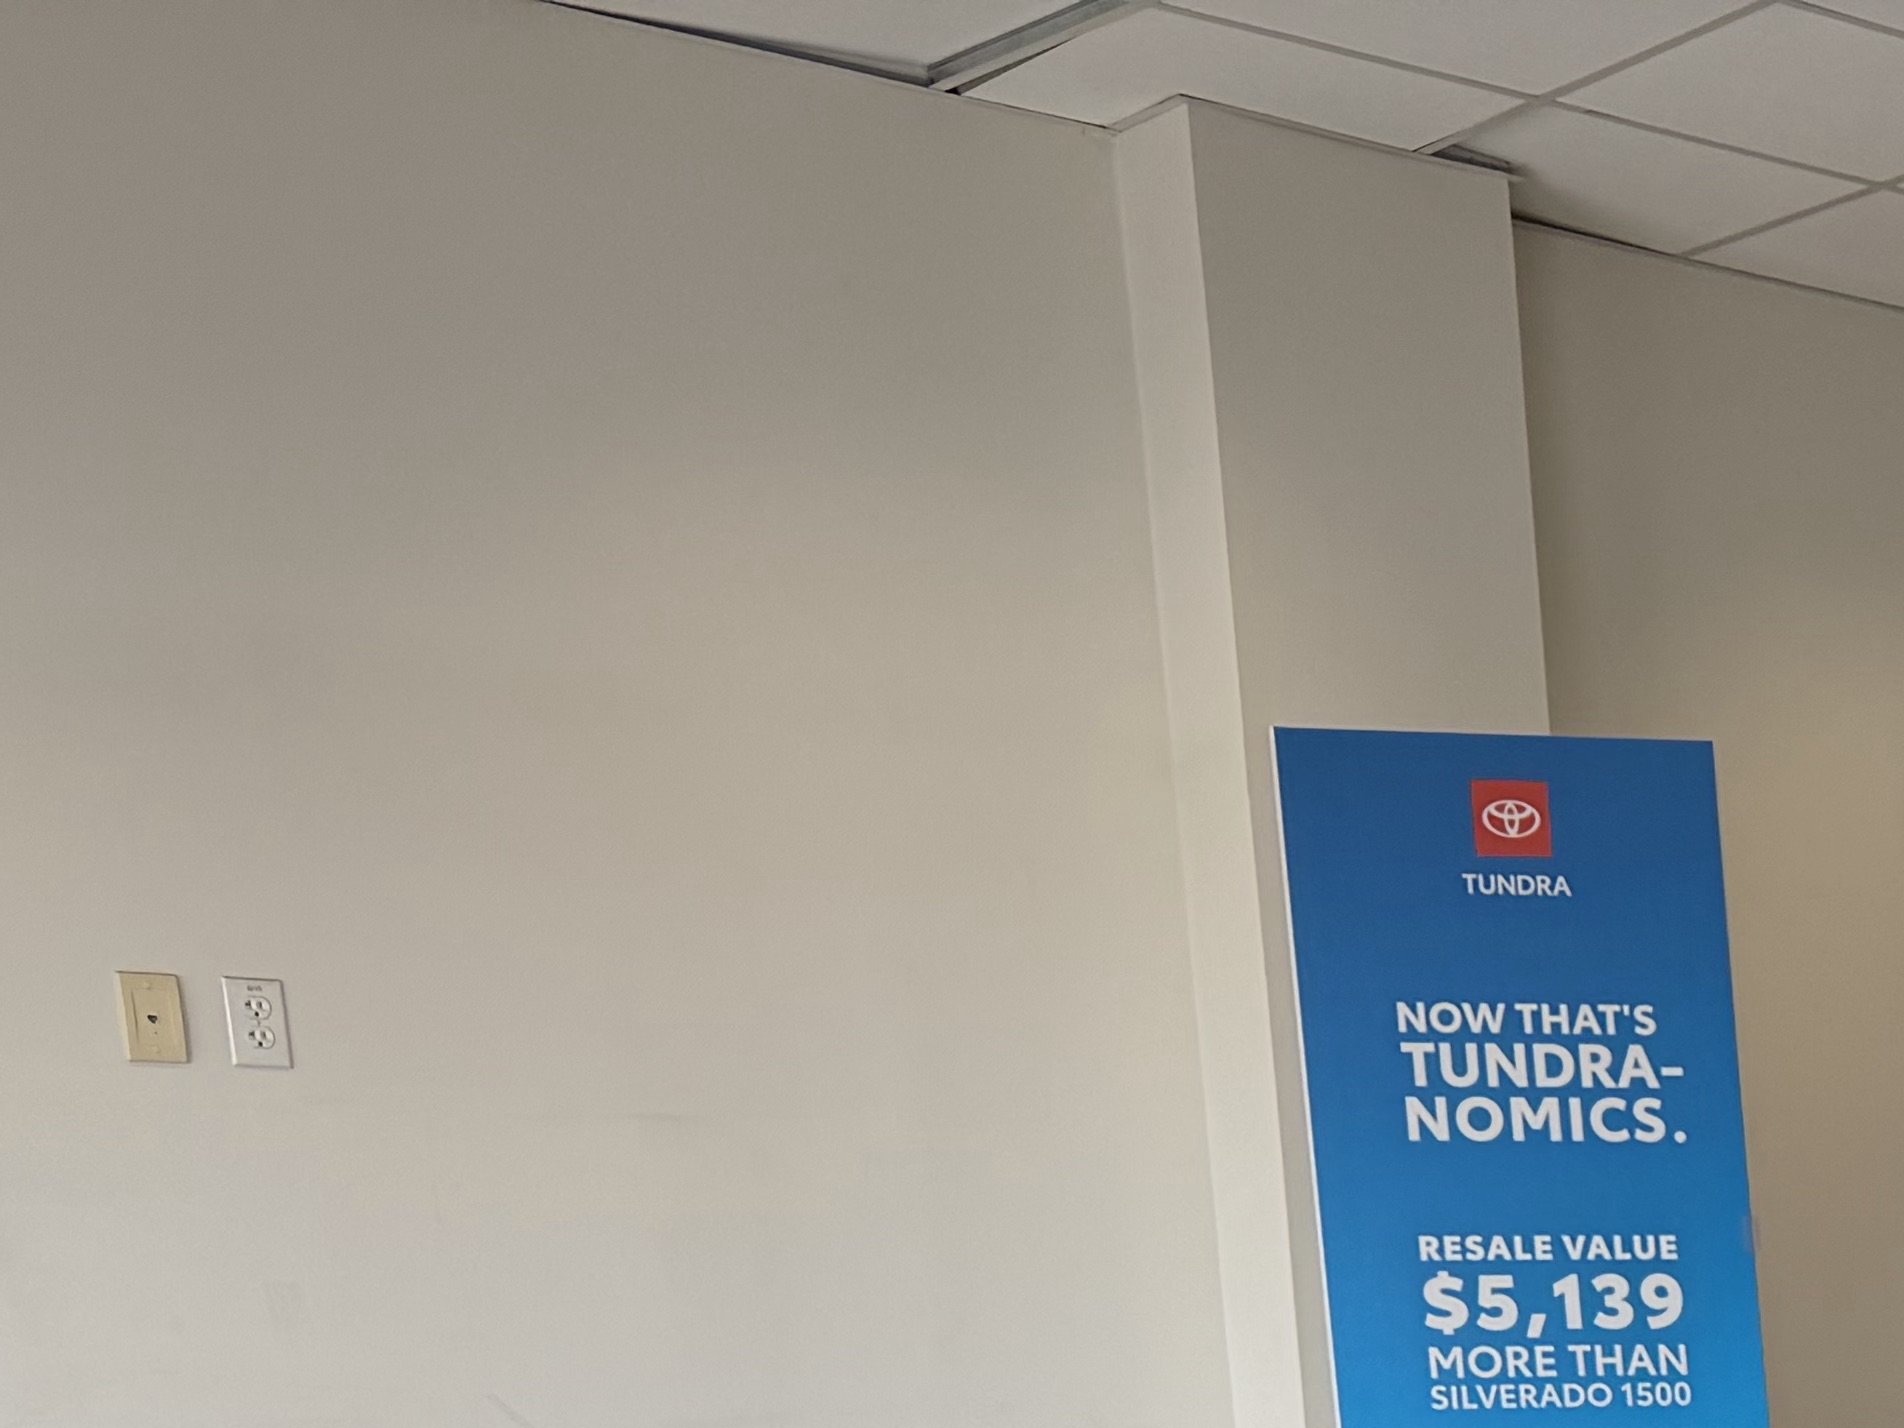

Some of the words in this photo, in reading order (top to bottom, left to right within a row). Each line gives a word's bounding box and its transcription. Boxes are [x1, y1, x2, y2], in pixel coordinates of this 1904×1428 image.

[1462, 873, 1572, 897] TUNDRA
[1395, 1001, 1503, 1034] NOW
[1514, 1003, 1657, 1037] THAT'S
[1400, 1041, 1684, 1090] TUNDRA-
[1404, 1095, 1688, 1145] NOMICS.
[1418, 1234, 1553, 1262] RESALE
[1561, 1234, 1679, 1261] VALUE
[1422, 1271, 1685, 1339] $5,139
[1428, 1345, 1558, 1380] MORE
[1568, 1343, 1689, 1377] THAN
[1430, 1383, 1613, 1411] SILVERADO
[1620, 1380, 1693, 1408] 1500
